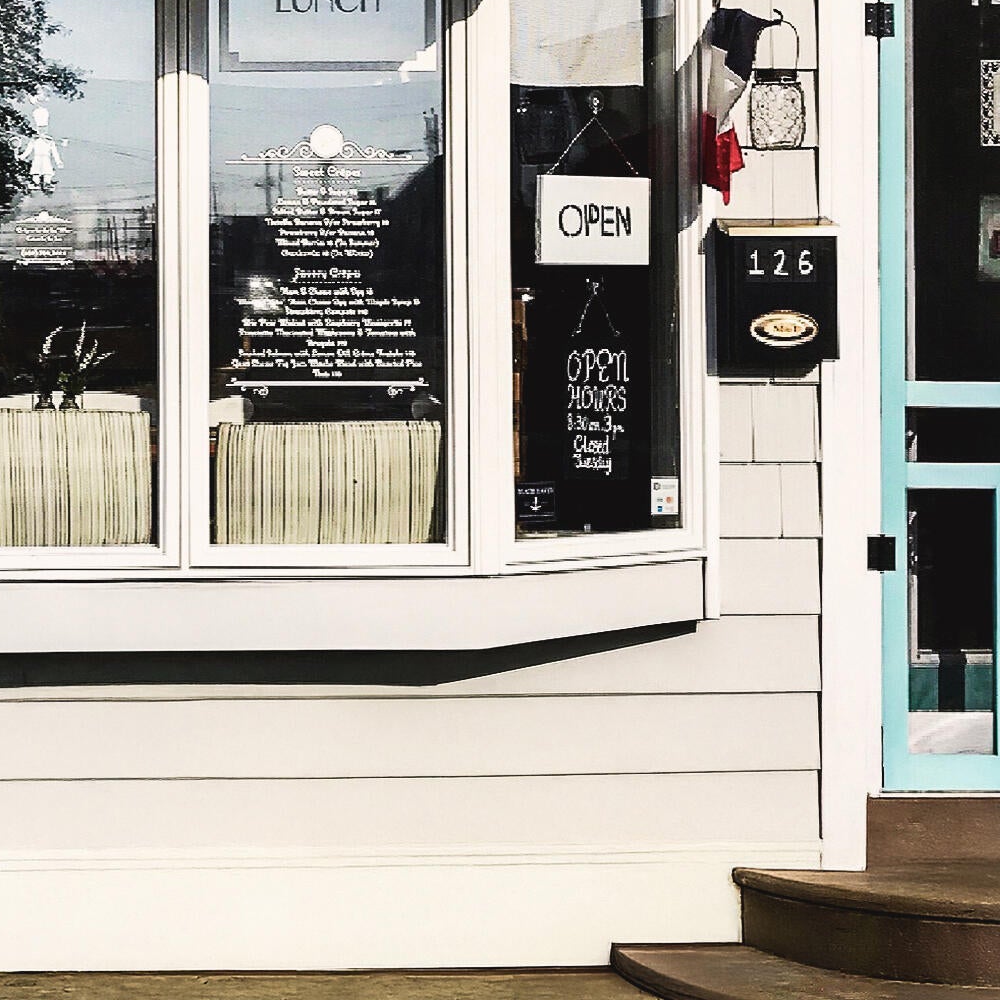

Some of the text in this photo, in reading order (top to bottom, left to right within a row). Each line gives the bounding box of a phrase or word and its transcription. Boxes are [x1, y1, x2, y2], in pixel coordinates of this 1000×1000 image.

[293, 167, 324, 177] Sweet
[558, 203, 632, 237] OPEN
[567, 384, 626, 411] HOURS
[573, 434, 609, 454] Closed
